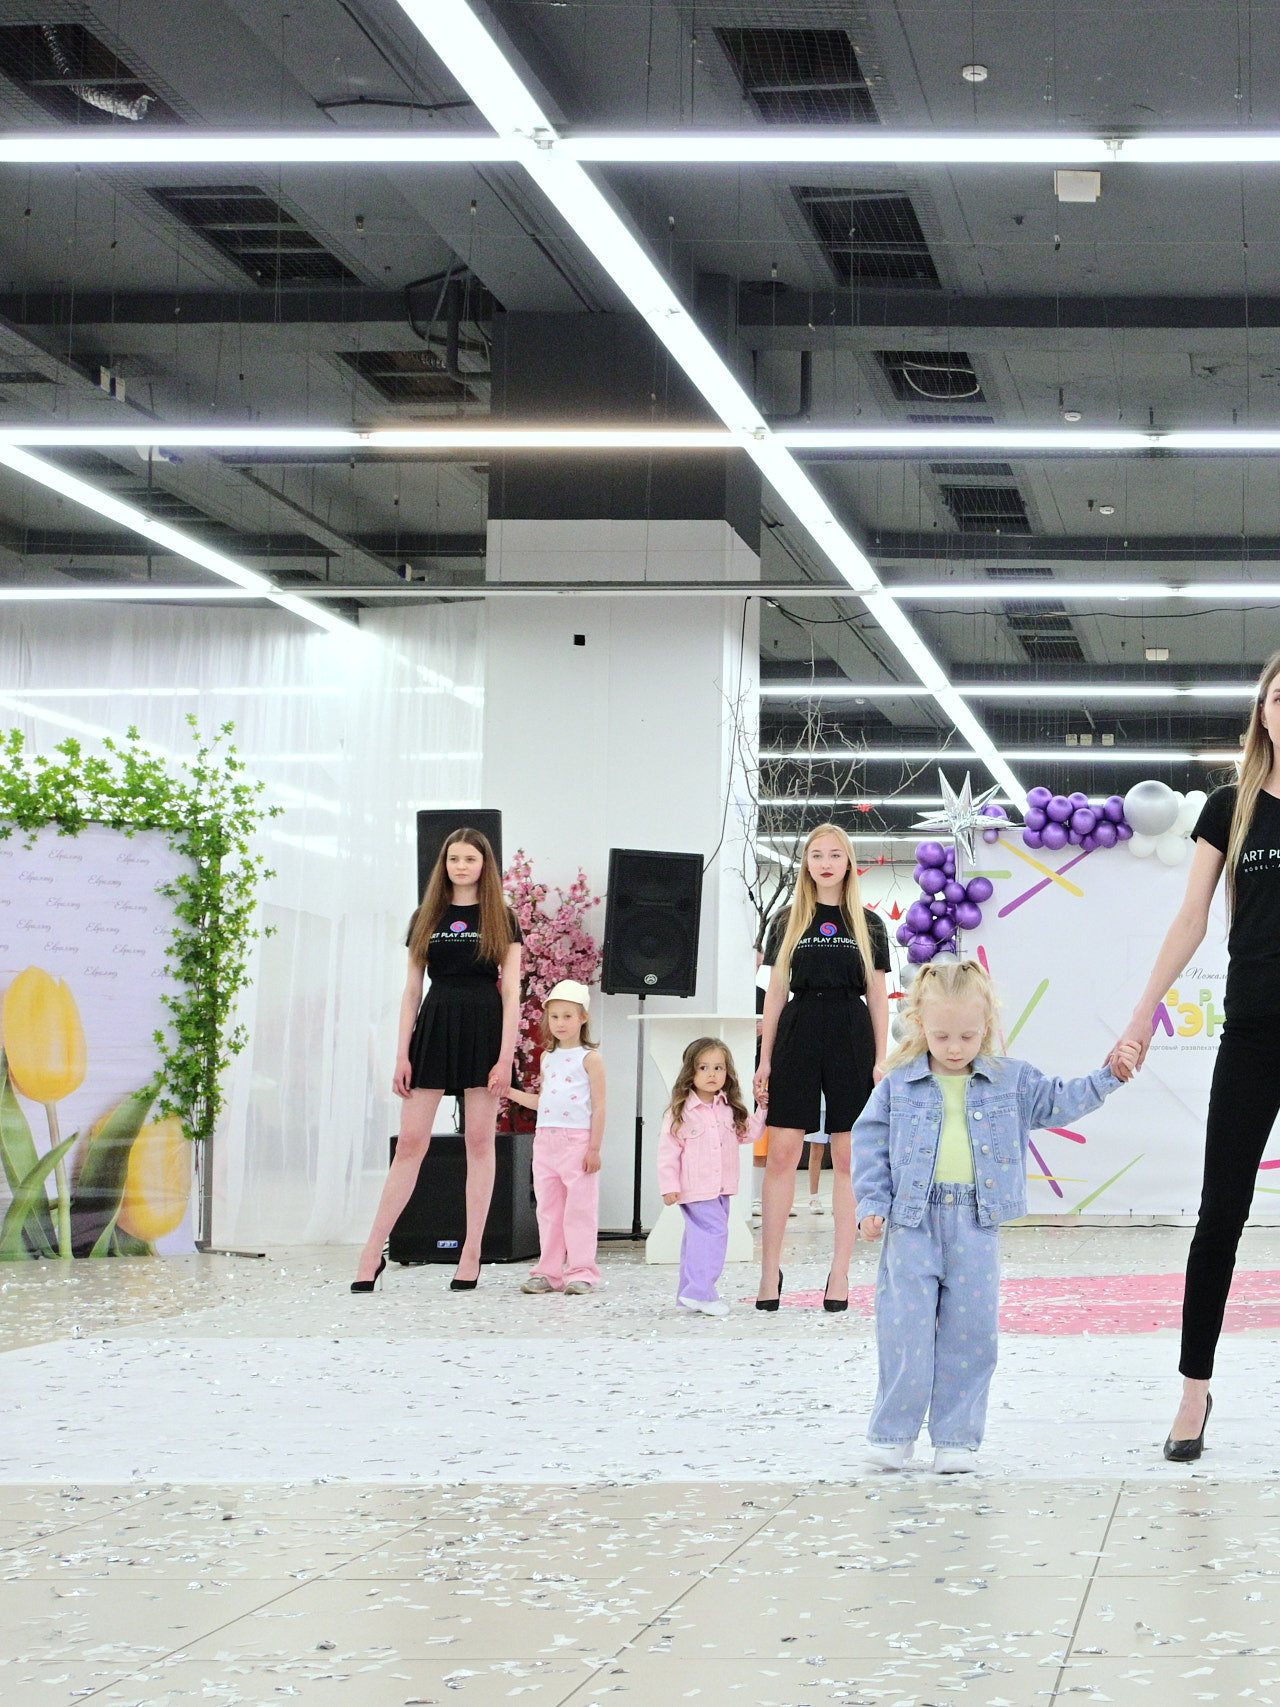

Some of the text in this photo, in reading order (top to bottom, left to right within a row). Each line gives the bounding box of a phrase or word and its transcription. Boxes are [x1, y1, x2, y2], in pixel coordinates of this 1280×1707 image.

[1242, 849, 1264, 864] ART
[798, 937, 812, 945] ART
[1152, 1002, 1227, 1037] ЛЭН
